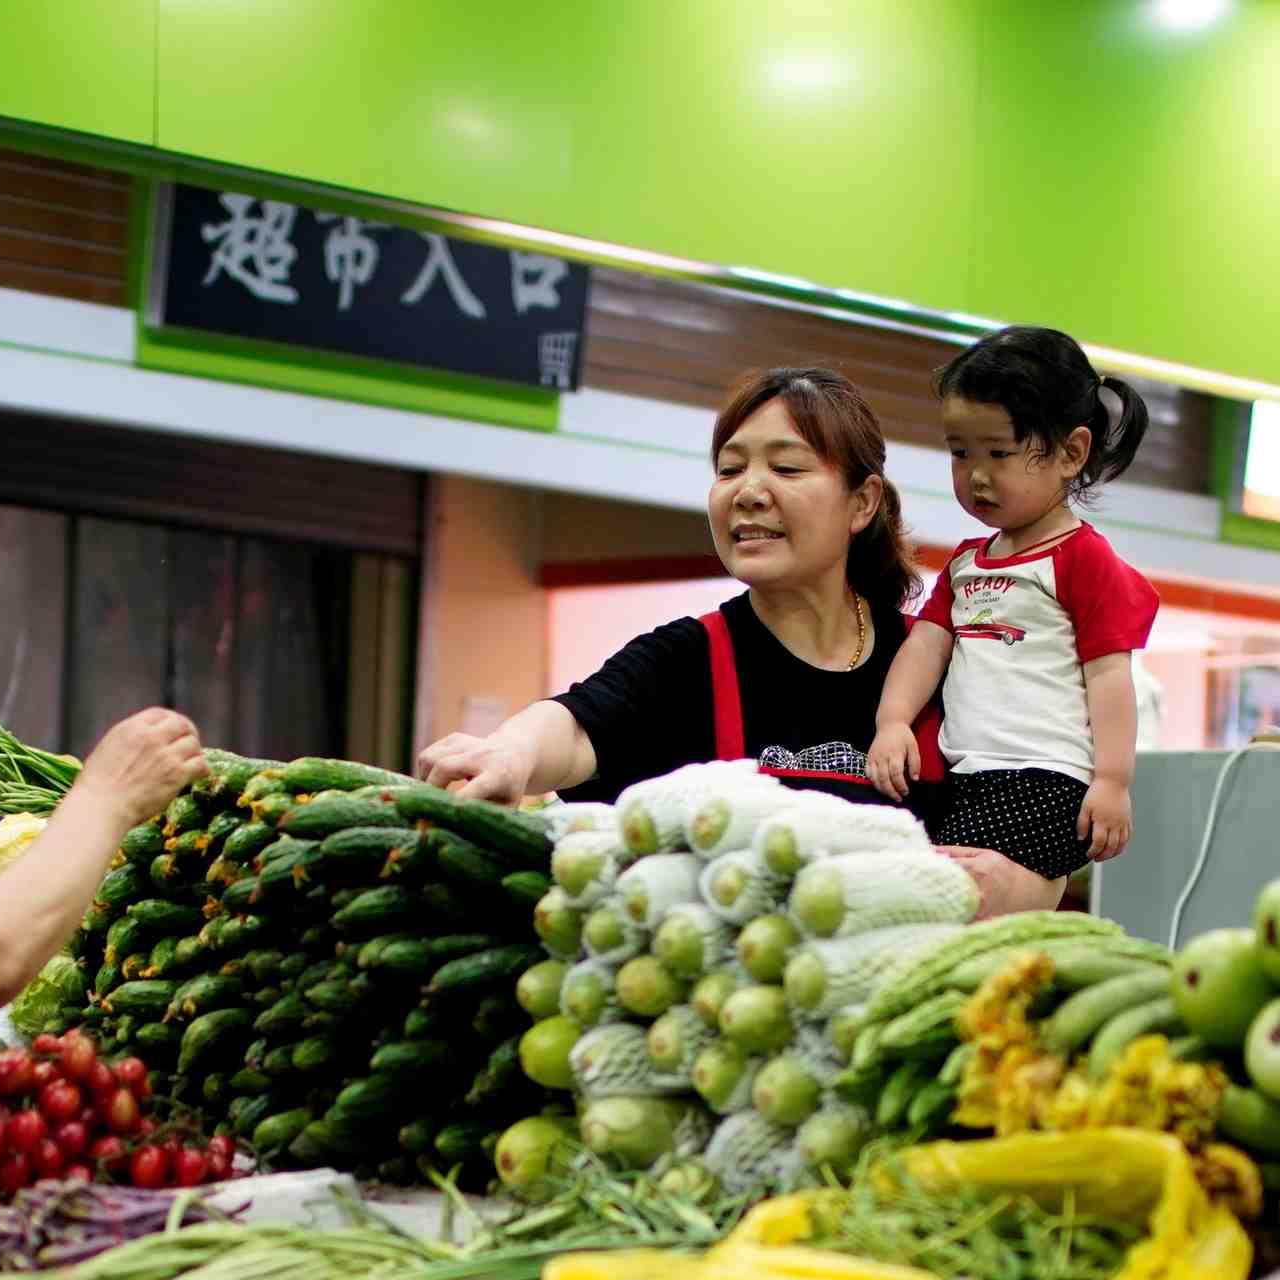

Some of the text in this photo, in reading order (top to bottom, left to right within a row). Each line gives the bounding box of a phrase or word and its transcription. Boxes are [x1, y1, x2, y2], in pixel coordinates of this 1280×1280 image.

[201, 191, 569, 319] 超市入口
[964, 576, 1017, 598] READY
